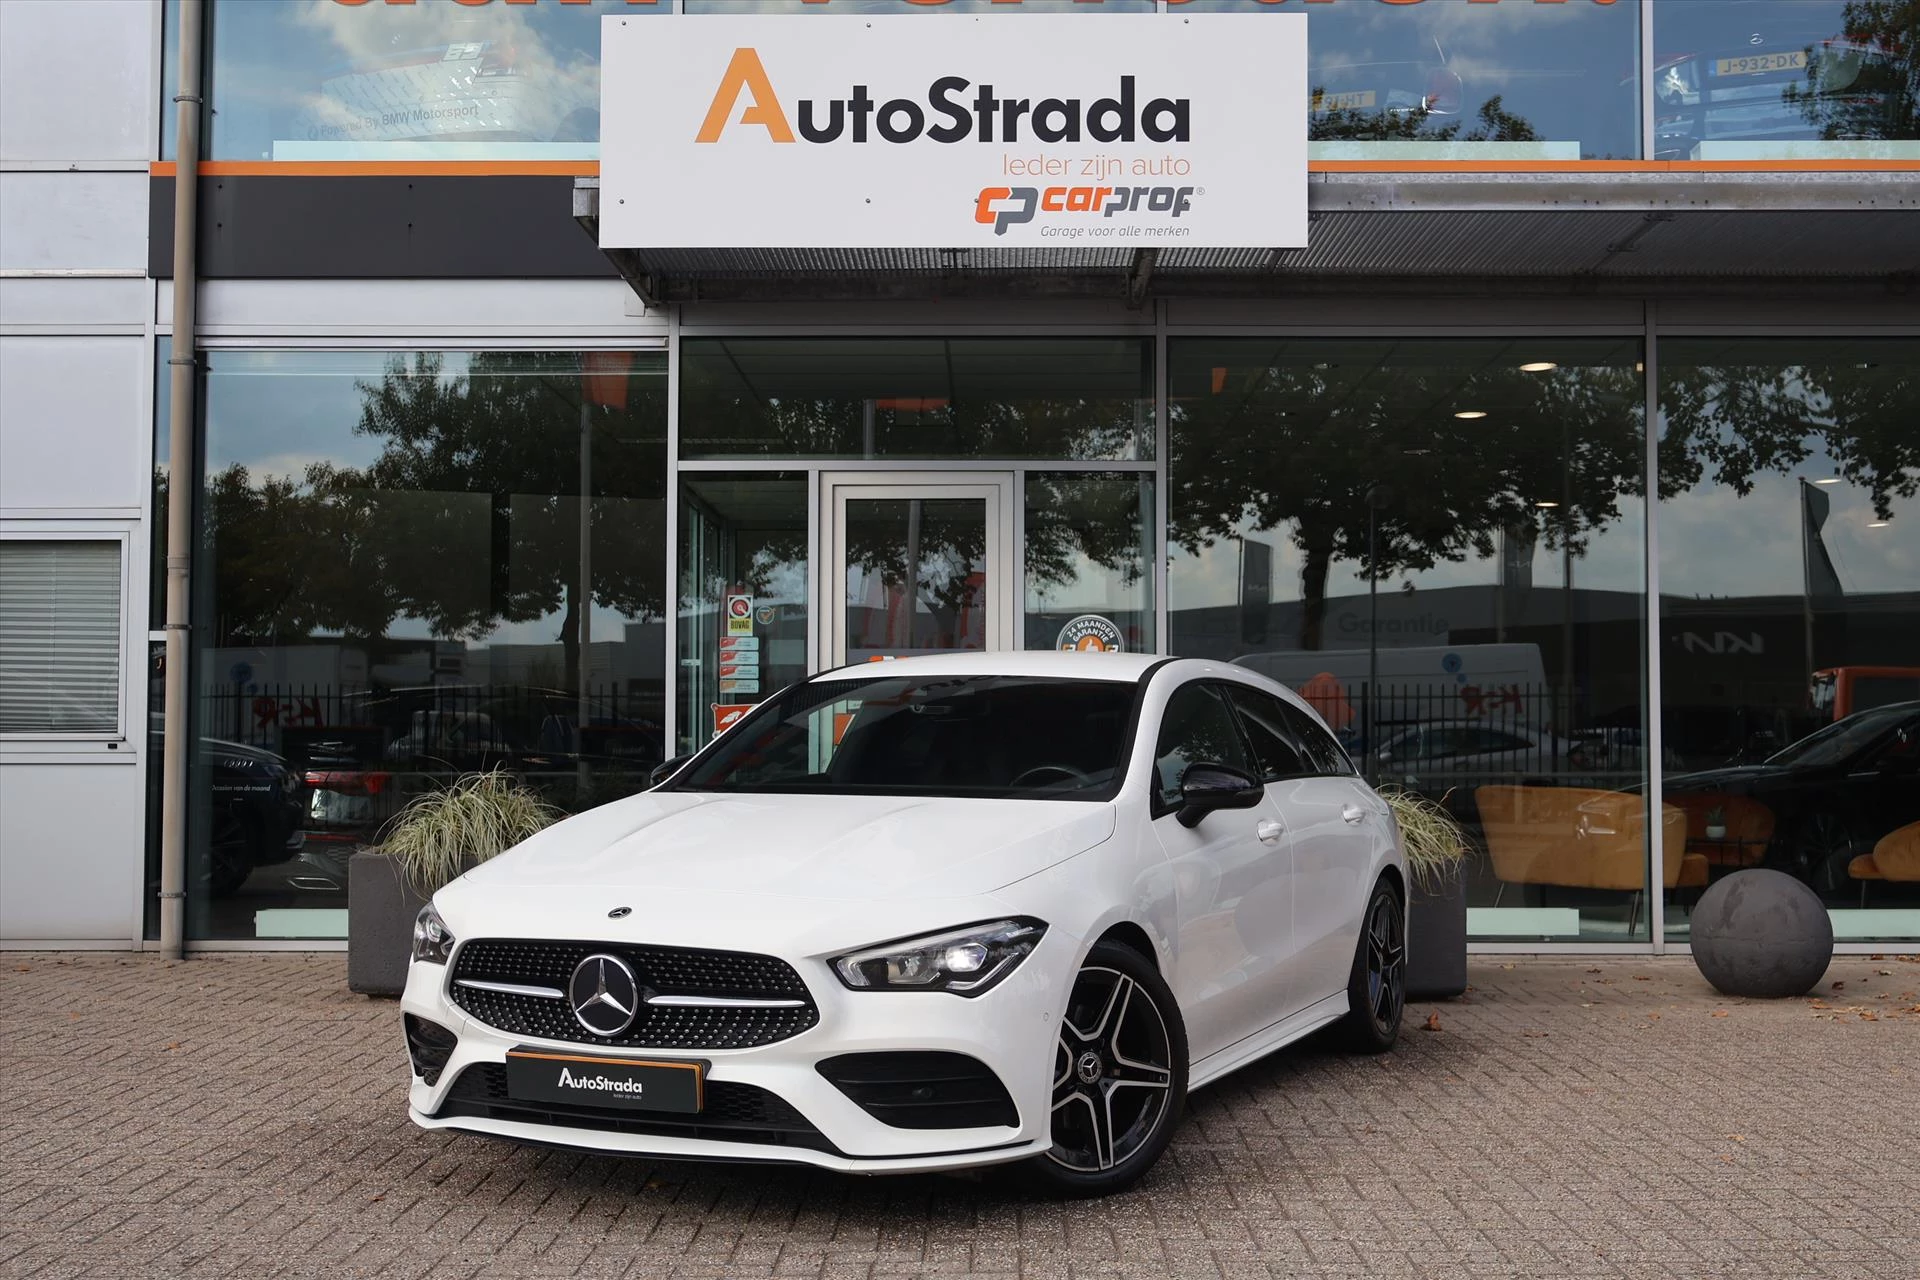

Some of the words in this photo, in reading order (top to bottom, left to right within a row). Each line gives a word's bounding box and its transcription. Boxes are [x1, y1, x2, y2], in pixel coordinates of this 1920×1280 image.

[1723, 54, 1800, 73] J-932-DK
[695, 48, 1191, 144] AutoStrada
[382, 111, 410, 126] BMW
[413, 104, 479, 121] Motorsport
[1002, 153, 1072, 176] Ieder
[1080, 154, 1123, 181] zijn
[1131, 157, 1191, 176] auto
[1040, 225, 1084, 240] Garage
[1088, 227, 1115, 237] voor
[1119, 225, 1141, 237] alle
[1144, 225, 1190, 237] merken
[730, 620, 750, 630] BOVAG
[1067, 627, 1077, 638] 24
[1076, 620, 1116, 639] MAANDEN
[1072, 627, 1110, 643] GARANTIE
[557, 1067, 643, 1093] AutoStrada
